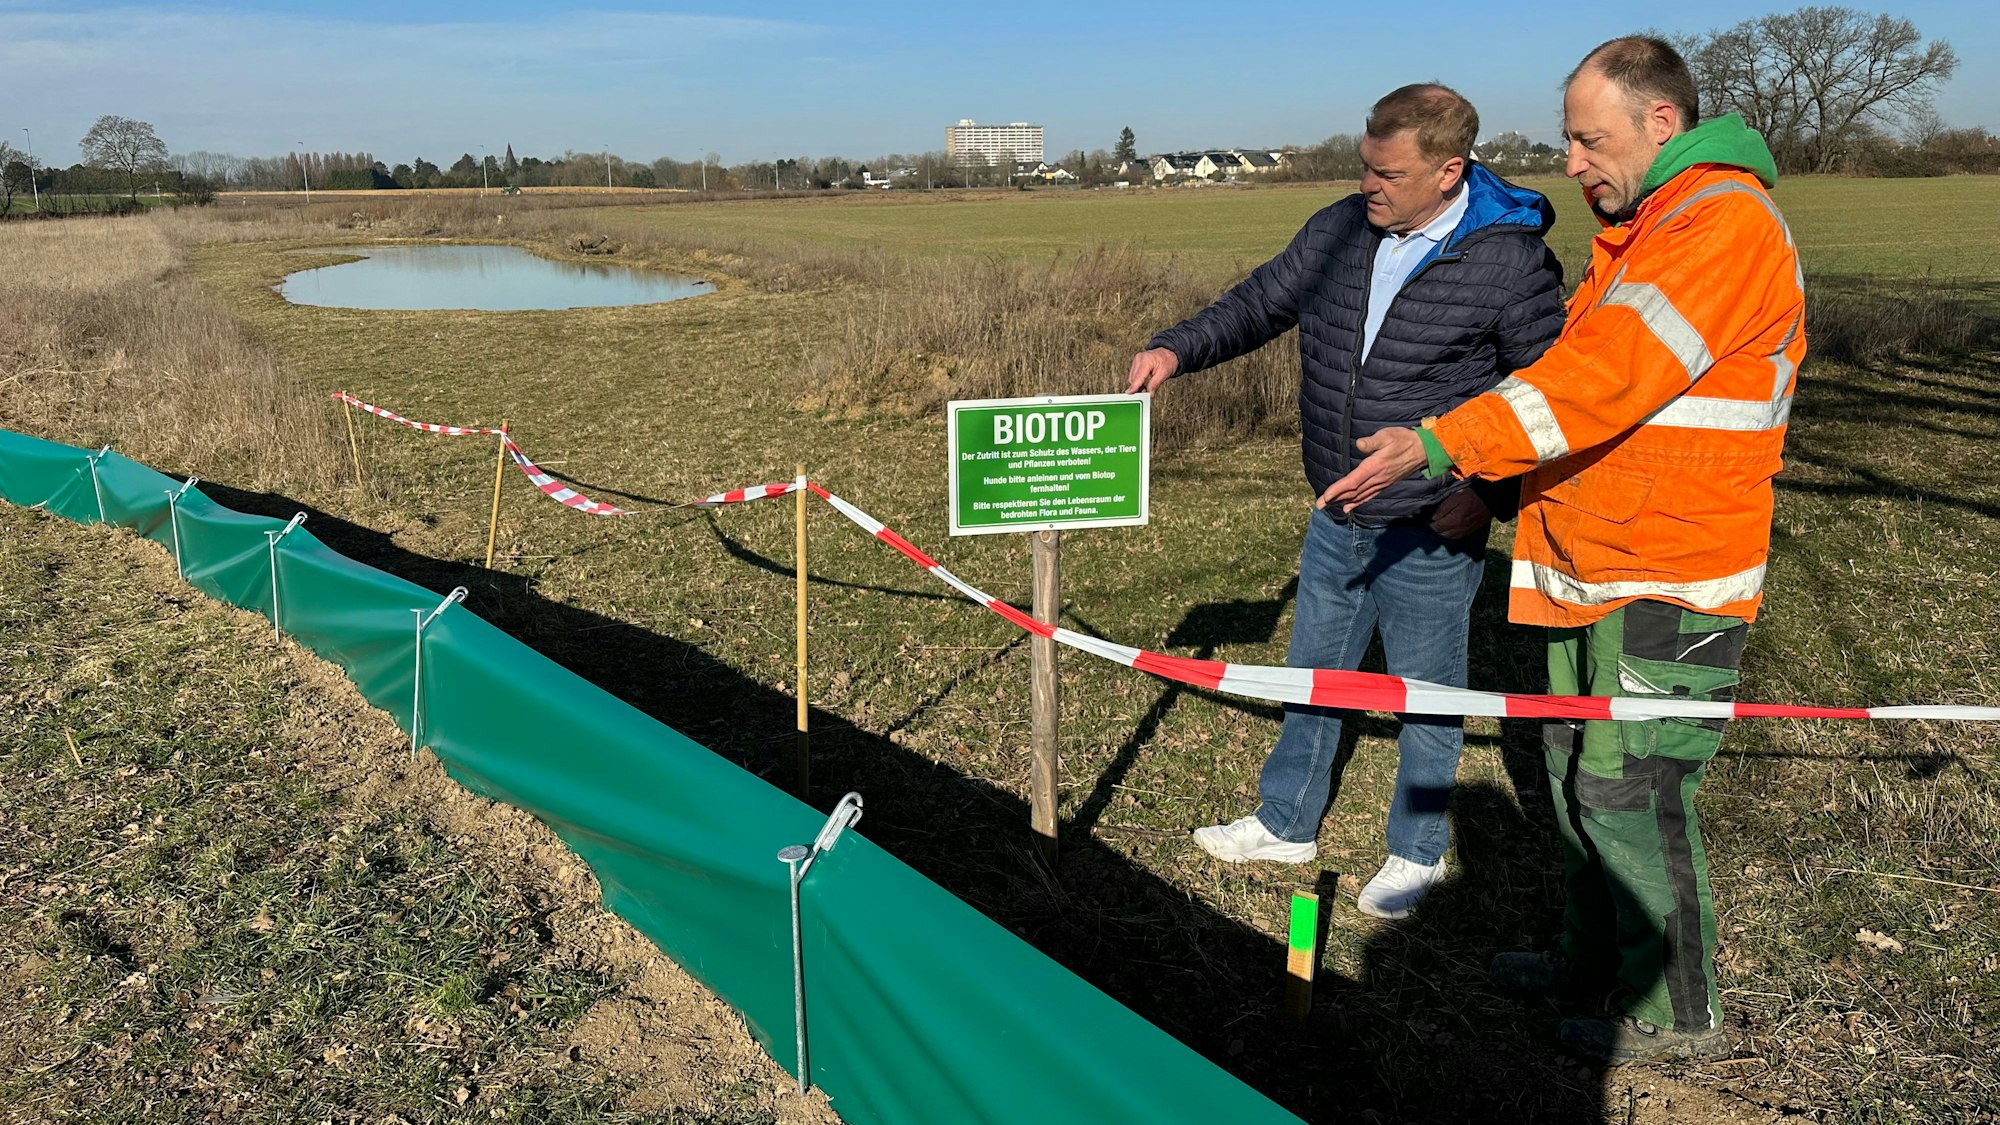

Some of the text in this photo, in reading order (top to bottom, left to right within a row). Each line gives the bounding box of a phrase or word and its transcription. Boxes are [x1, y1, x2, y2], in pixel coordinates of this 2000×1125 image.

[994, 411, 1106, 444] BIOTOP
[962, 452, 975, 460] Der
[1030, 449, 1054, 457] Schutz
[1056, 448, 1069, 456] des
[1071, 447, 1103, 455] Wassers,
[1008, 458, 1091, 469] und Pflanzen verboten!
[1009, 475, 1025, 483] bitte
[1027, 474, 1058, 482] anleinen
[1093, 472, 1115, 481] Biotop
[1030, 484, 1069, 493] fernhalten!
[973, 502, 990, 510] Bitte
[992, 500, 1038, 510] respektieren
[1039, 498, 1051, 506] Sie
[1068, 496, 1112, 504] Lebensraum
[1001, 506, 1098, 519] bedrohten Flora und Fauna.
